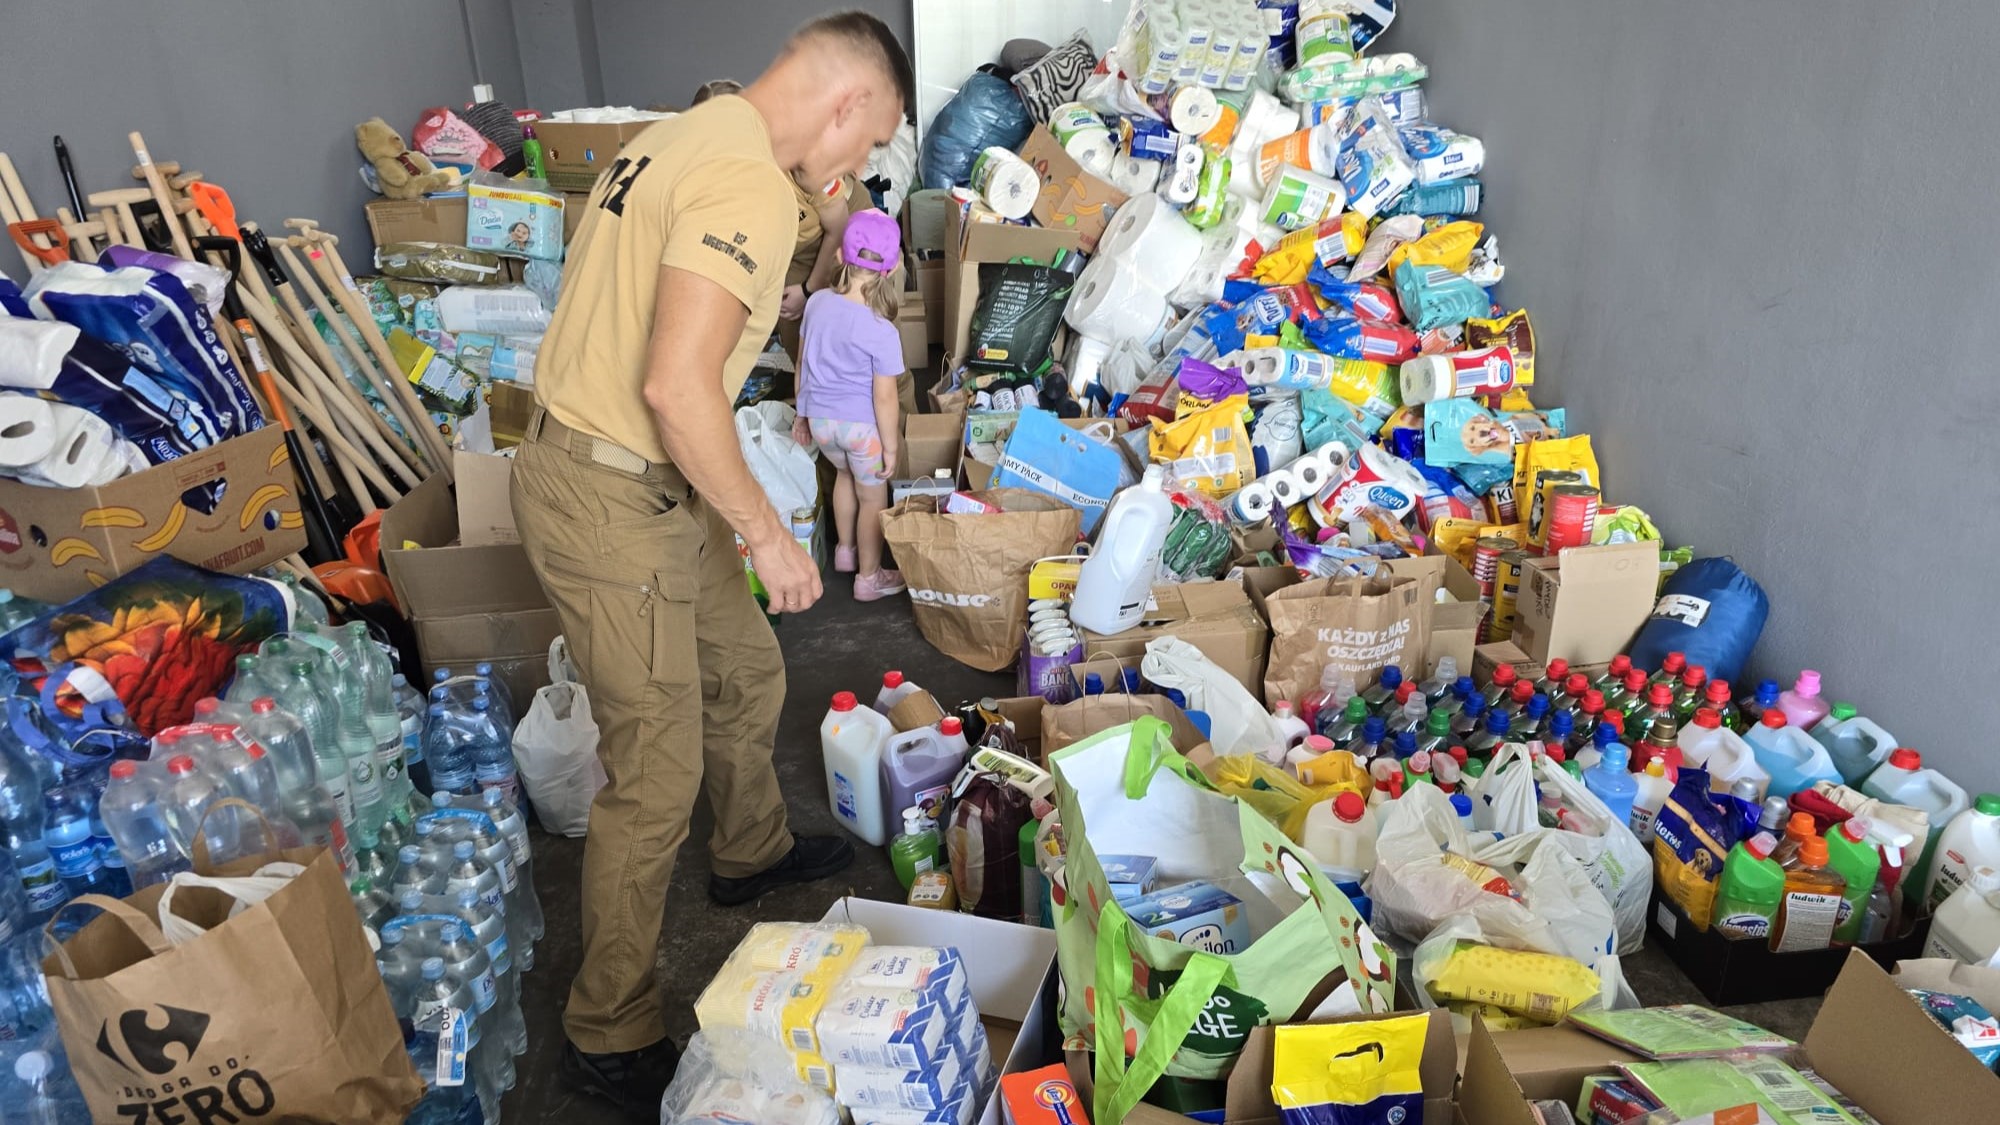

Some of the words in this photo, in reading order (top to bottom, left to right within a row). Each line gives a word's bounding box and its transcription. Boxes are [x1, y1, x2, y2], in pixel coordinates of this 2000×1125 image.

[1020, 465, 1043, 483] PACK
[1072, 493, 1109, 507] ECONO
[1369, 487, 1405, 509] Queen
[1318, 627, 1378, 646] KAŻDY
[1388, 619, 1410, 639] NAS
[1327, 636, 1405, 660] OSZCZĘDZA!
[1339, 660, 1383, 672] KAUFLAND
[1791, 893, 1826, 904] ludwik
[882, 955, 900, 977] Cukier
[859, 995, 876, 1019] Cukier
[124, 1077, 192, 1098] DROGA
[208, 1057, 238, 1077] DO
